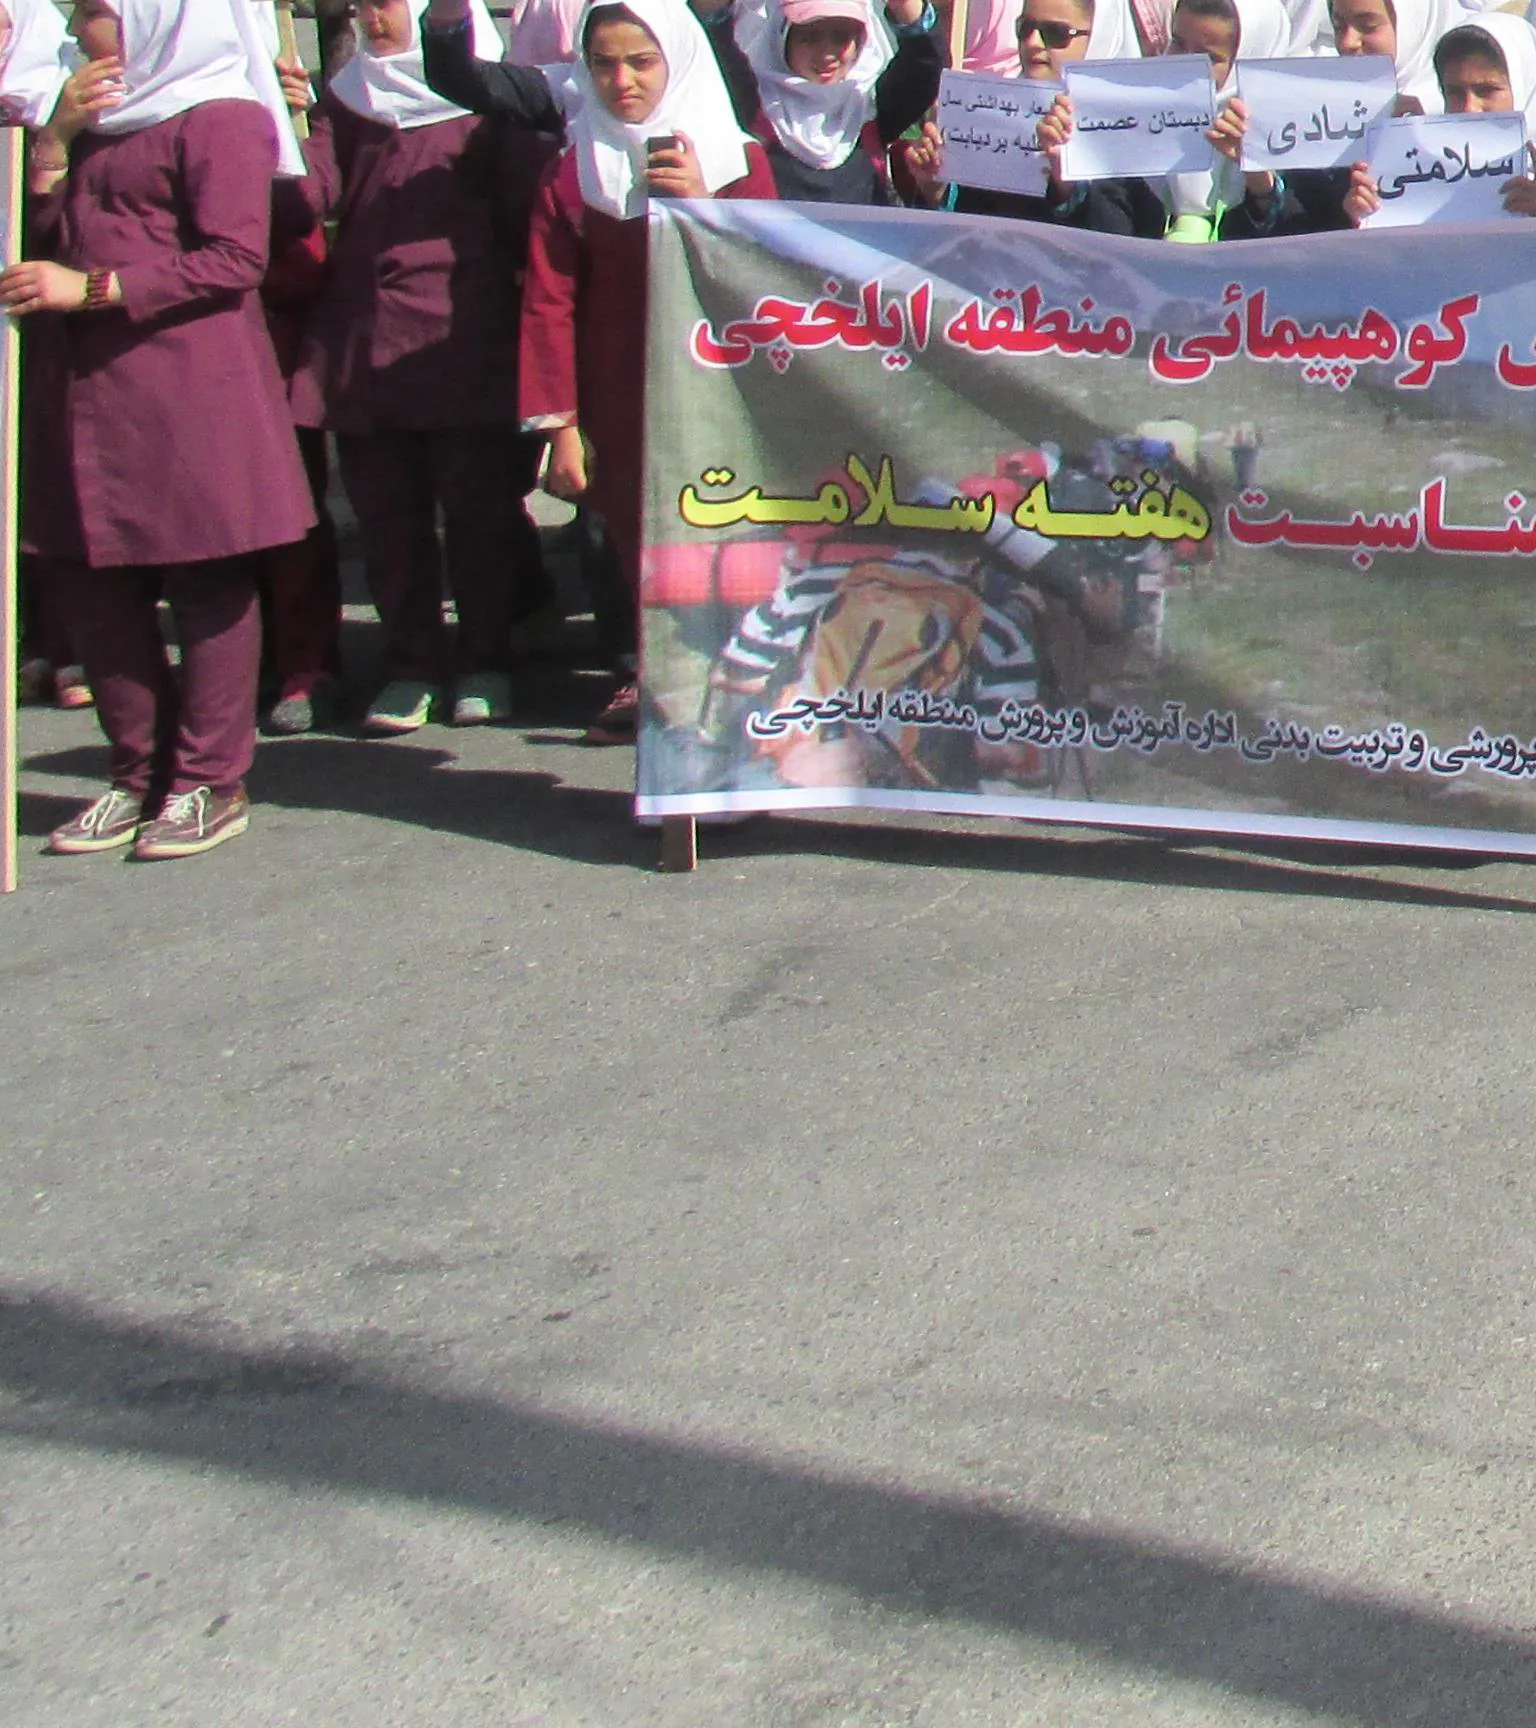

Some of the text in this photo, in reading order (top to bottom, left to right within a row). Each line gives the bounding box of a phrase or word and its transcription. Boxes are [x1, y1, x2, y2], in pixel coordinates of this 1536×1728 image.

[942, 90, 962, 107] سال
[965, 93, 1019, 117] بهداشتی
[1076, 105, 1212, 136] دبستان عصمت
[993, 136, 1008, 153] بر
[1266, 99, 1368, 156] شادی
[1377, 142, 1515, 200] سلامتی
[690, 277, 933, 373] ایلخچی
[944, 281, 1136, 359] منطقه
[678, 452, 996, 535] سلامت
[1011, 467, 1213, 543] هفته
[745, 684, 888, 742] ایلخچی
[892, 690, 978, 734] منطقه
[980, 699, 1067, 747] پرورش
[1067, 711, 1088, 743] و
[1091, 701, 1185, 754] آموزش
[1186, 708, 1236, 750] اداره
[1240, 718, 1311, 762] بدنی
[1315, 722, 1406, 773] تربیت
[1405, 731, 1429, 769] و
